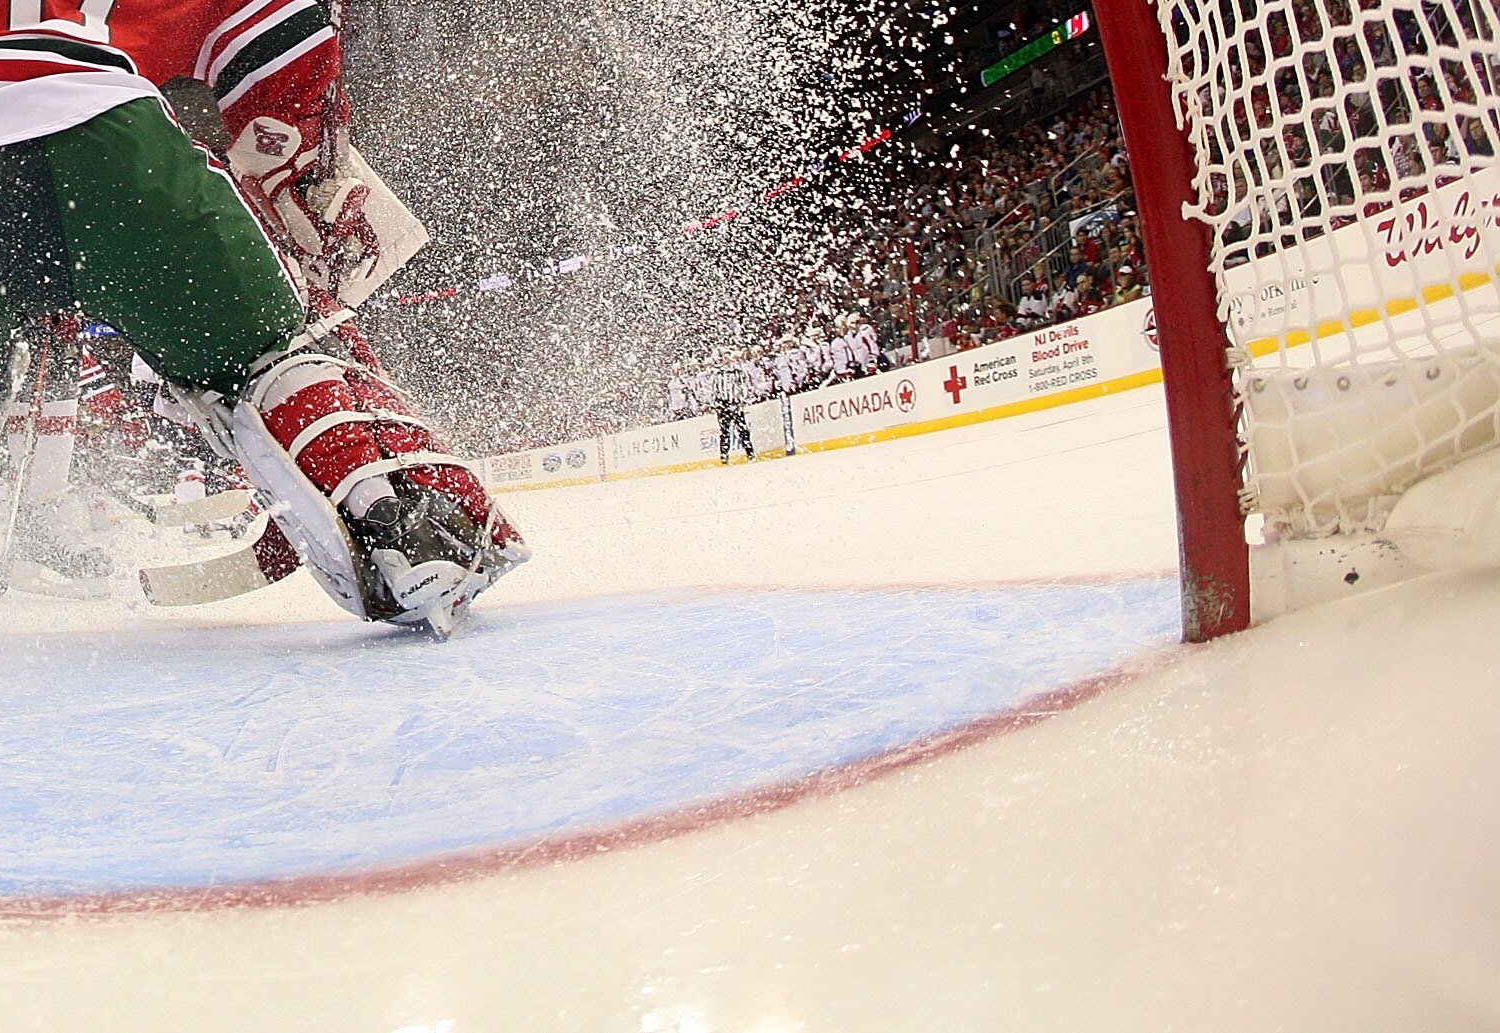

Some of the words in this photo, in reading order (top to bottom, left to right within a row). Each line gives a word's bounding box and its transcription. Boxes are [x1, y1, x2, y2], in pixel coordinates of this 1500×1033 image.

[1034, 334, 1046, 346] NJ
[1049, 325, 1079, 342] Devils
[1032, 348, 1060, 363] Blood
[1063, 339, 1089, 355] Drive
[973, 355, 1016, 374] American
[1063, 357, 1079, 371] April
[1081, 354, 1094, 366] 9th
[974, 375, 991, 387] Red
[992, 368, 1018, 383] Cross
[1069, 368, 1098, 383] CROSS
[802, 404, 825, 425] AIR
[827, 391, 893, 421] CANADA
